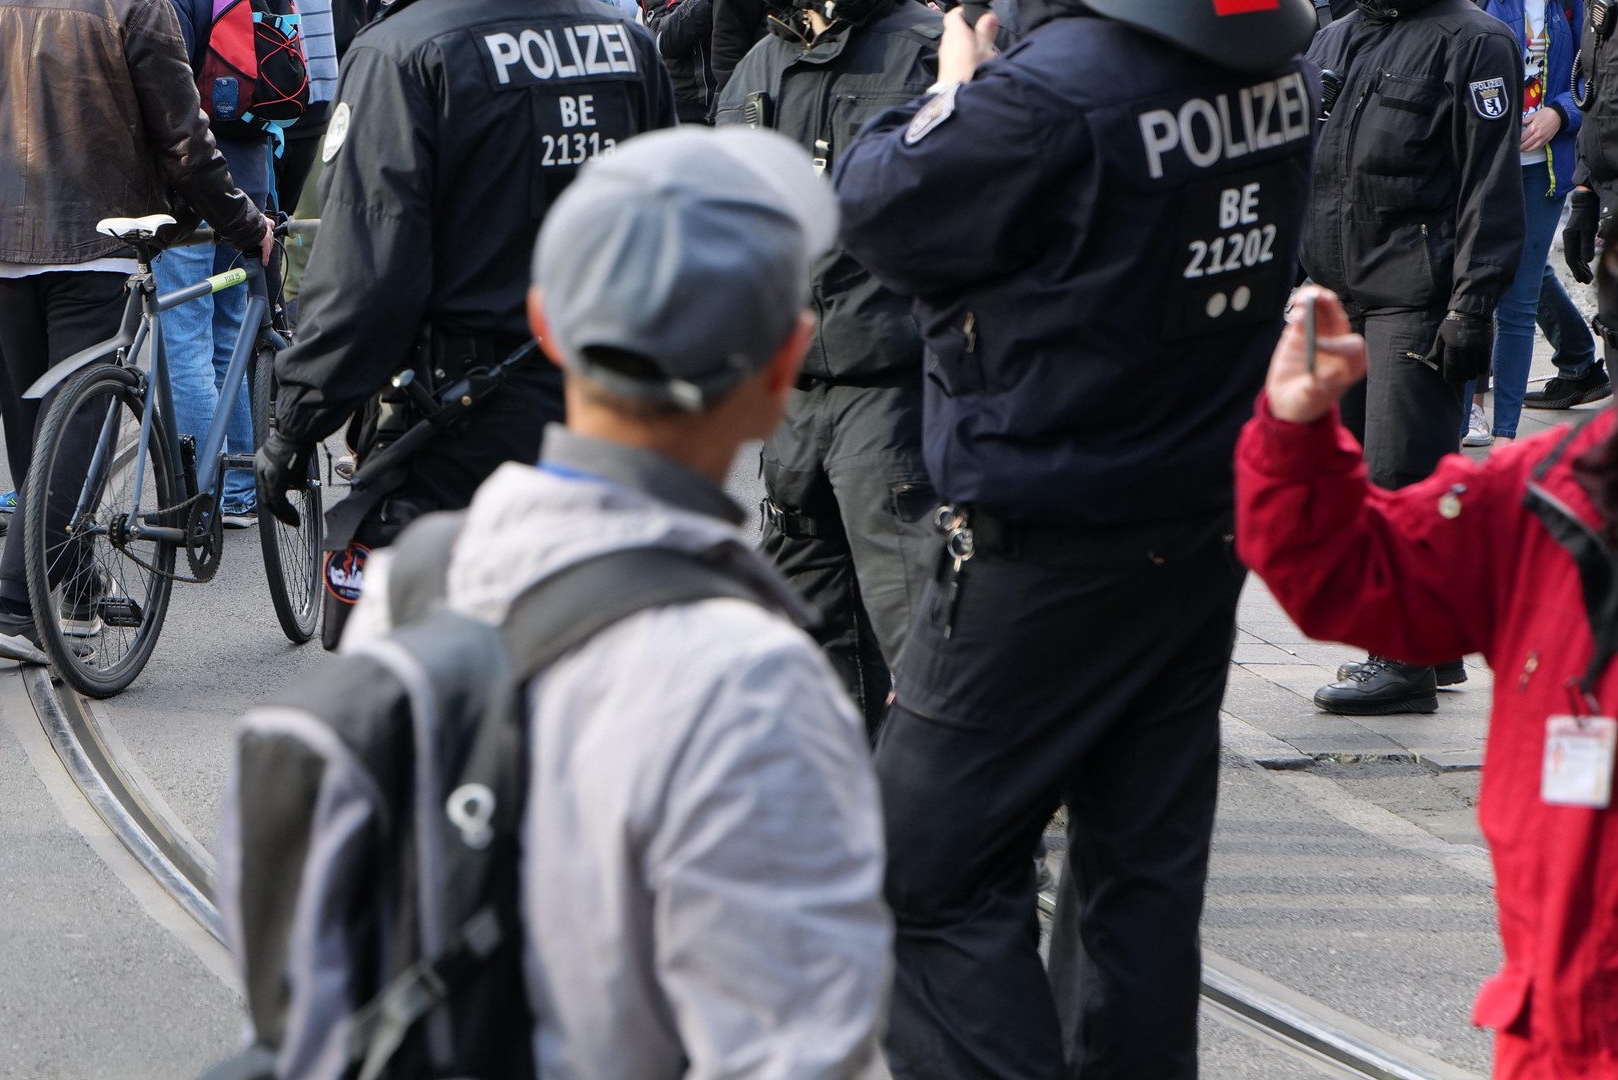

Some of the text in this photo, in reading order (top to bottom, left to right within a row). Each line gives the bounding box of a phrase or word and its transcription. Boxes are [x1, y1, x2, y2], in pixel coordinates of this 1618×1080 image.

[484, 24, 636, 84] POLIZEI
[559, 95, 596, 127] BE
[1138, 72, 1310, 179] POLIZEI
[1219, 182, 1260, 229] BE
[1183, 223, 1277, 278] 21202
